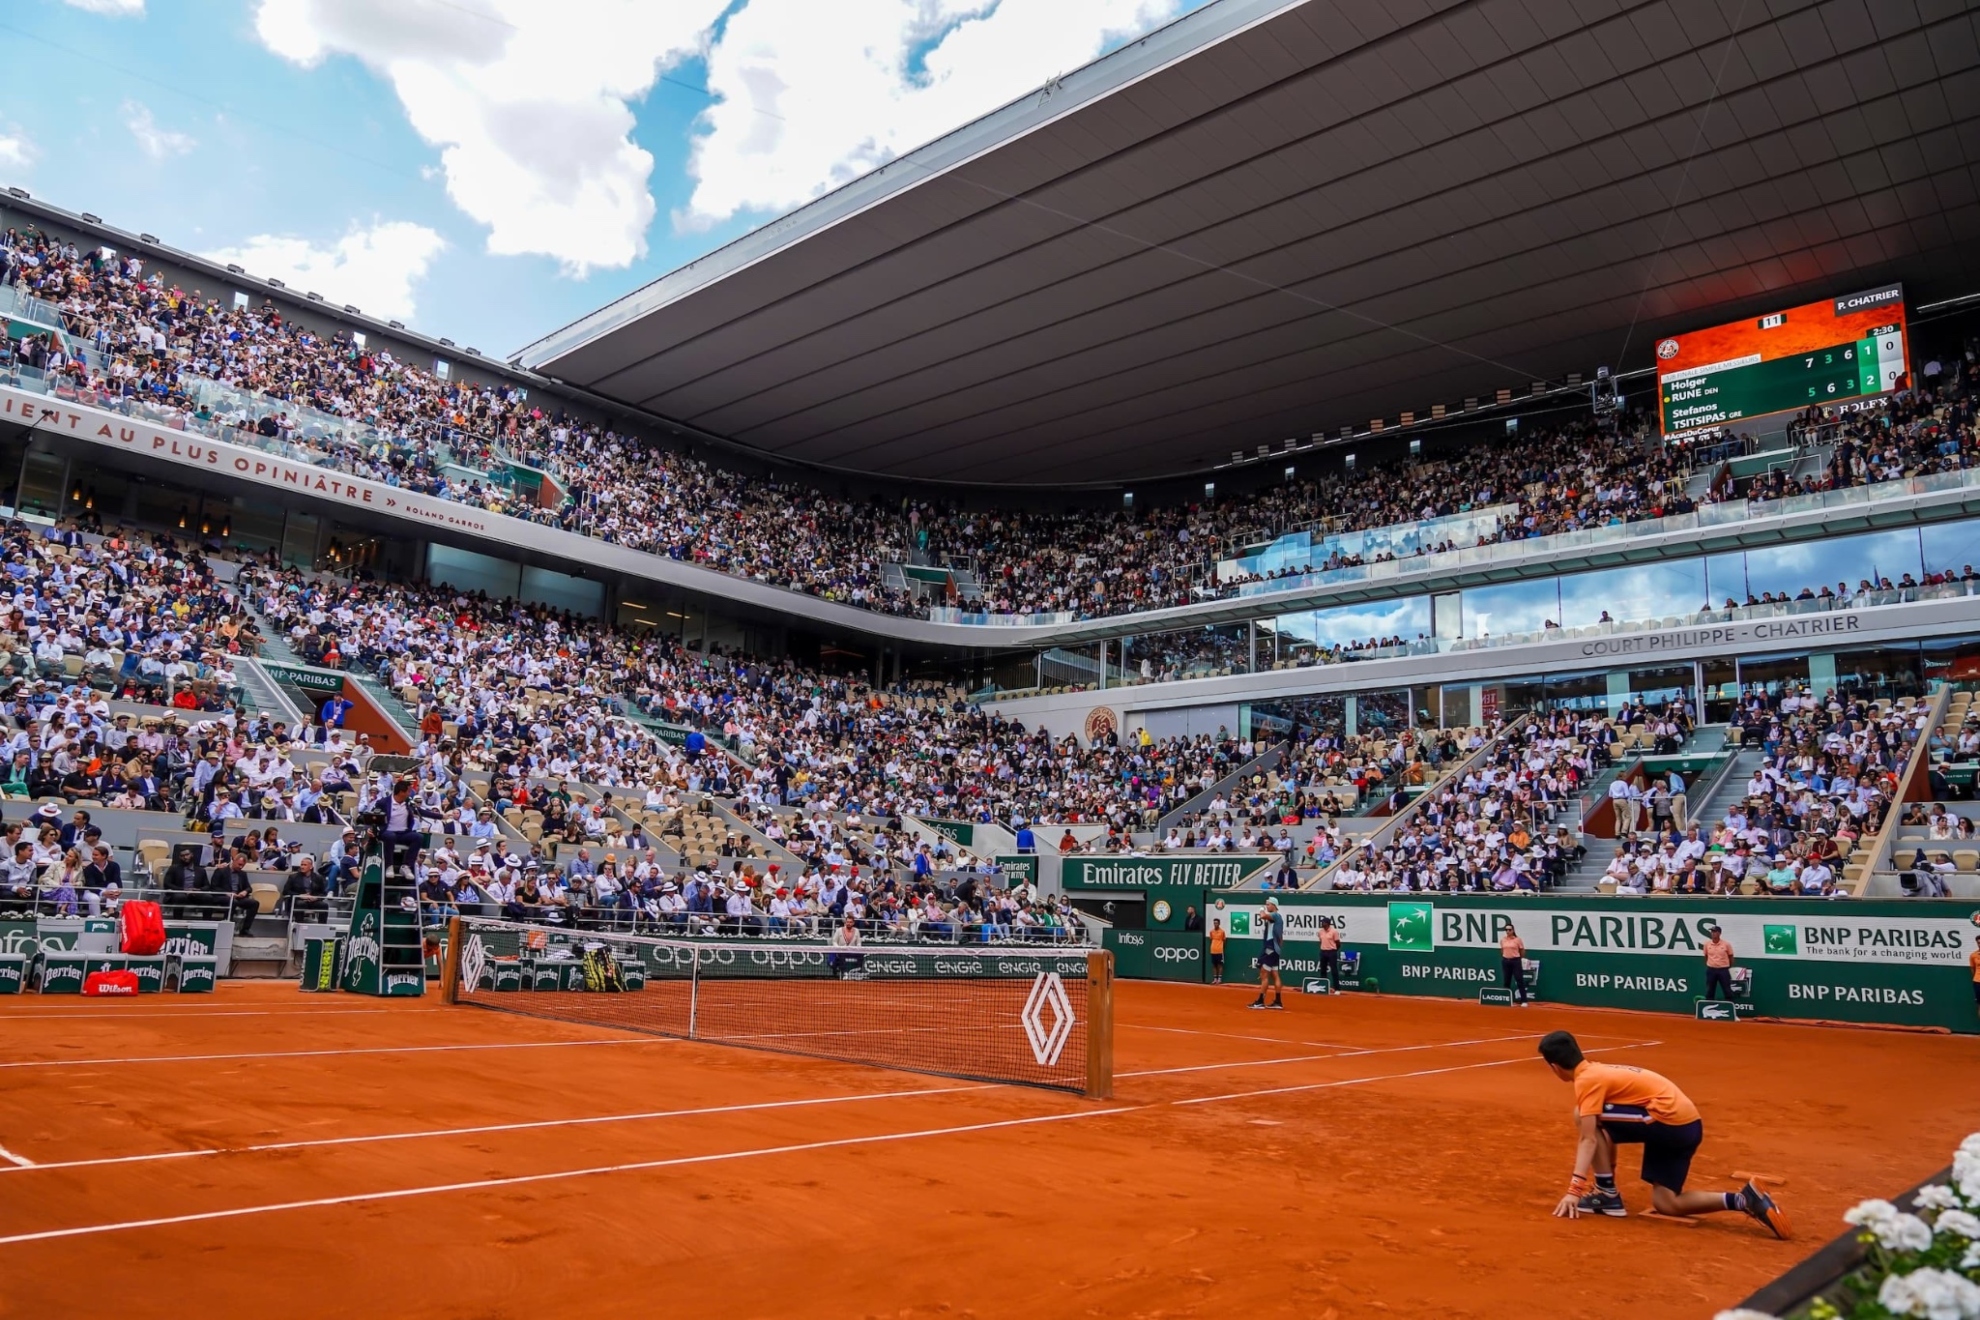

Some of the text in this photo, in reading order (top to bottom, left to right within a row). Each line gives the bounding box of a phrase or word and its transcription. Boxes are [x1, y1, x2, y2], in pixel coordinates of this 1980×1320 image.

[1848, 290, 1899, 308] CHATRIER
[1766, 316, 1779, 326] 11
[1873, 325, 1894, 336] 2:30
[1805, 341, 1894, 368] 7 3 6 1 0
[1671, 377, 1707, 391] Holger
[1808, 371, 1897, 397] 5 6 3 2 0
[1671, 387, 1718, 402] RUNE DEN
[1672, 403, 1718, 418] Stefanos
[1672, 410, 1742, 429] TSITSIPAS GRE
[97, 423, 135, 443] AU
[153, 436, 218, 464] PLUS
[234, 457, 373, 502] OPINIÂTRE
[406, 505, 485, 531] ROLAND GARROS
[1582, 637, 1643, 656] COURT
[1650, 628, 1735, 650] PHILIPPE
[1754, 615, 1859, 638] CHATRIER
[289, 671, 337, 687] PARIBAS
[653, 729, 686, 740] PARIBAS
[1083, 863, 1241, 886] Emirates FLY BETTER
[1442, 913, 1512, 943] BNP
[1118, 932, 1144, 946] Infosys
[1804, 927, 1962, 949] BNP PARIBAS
[653, 945, 736, 970] oppo
[751, 949, 824, 970] oppo
[1154, 946, 1200, 963] oppo
[1806, 946, 1824, 955] The
[1827, 947, 1850, 956] bank
[1853, 947, 1868, 957] for
[1880, 949, 1928, 960] changing
[1931, 951, 1962, 960] world
[1402, 965, 1496, 982] BNP PARIBAS
[1576, 973, 1688, 992] BNP PARIBAS
[98, 983, 133, 993] Wilson
[1788, 984, 1924, 1005] BNP PARIBAS
[1482, 994, 1509, 1002] LACOSTE
